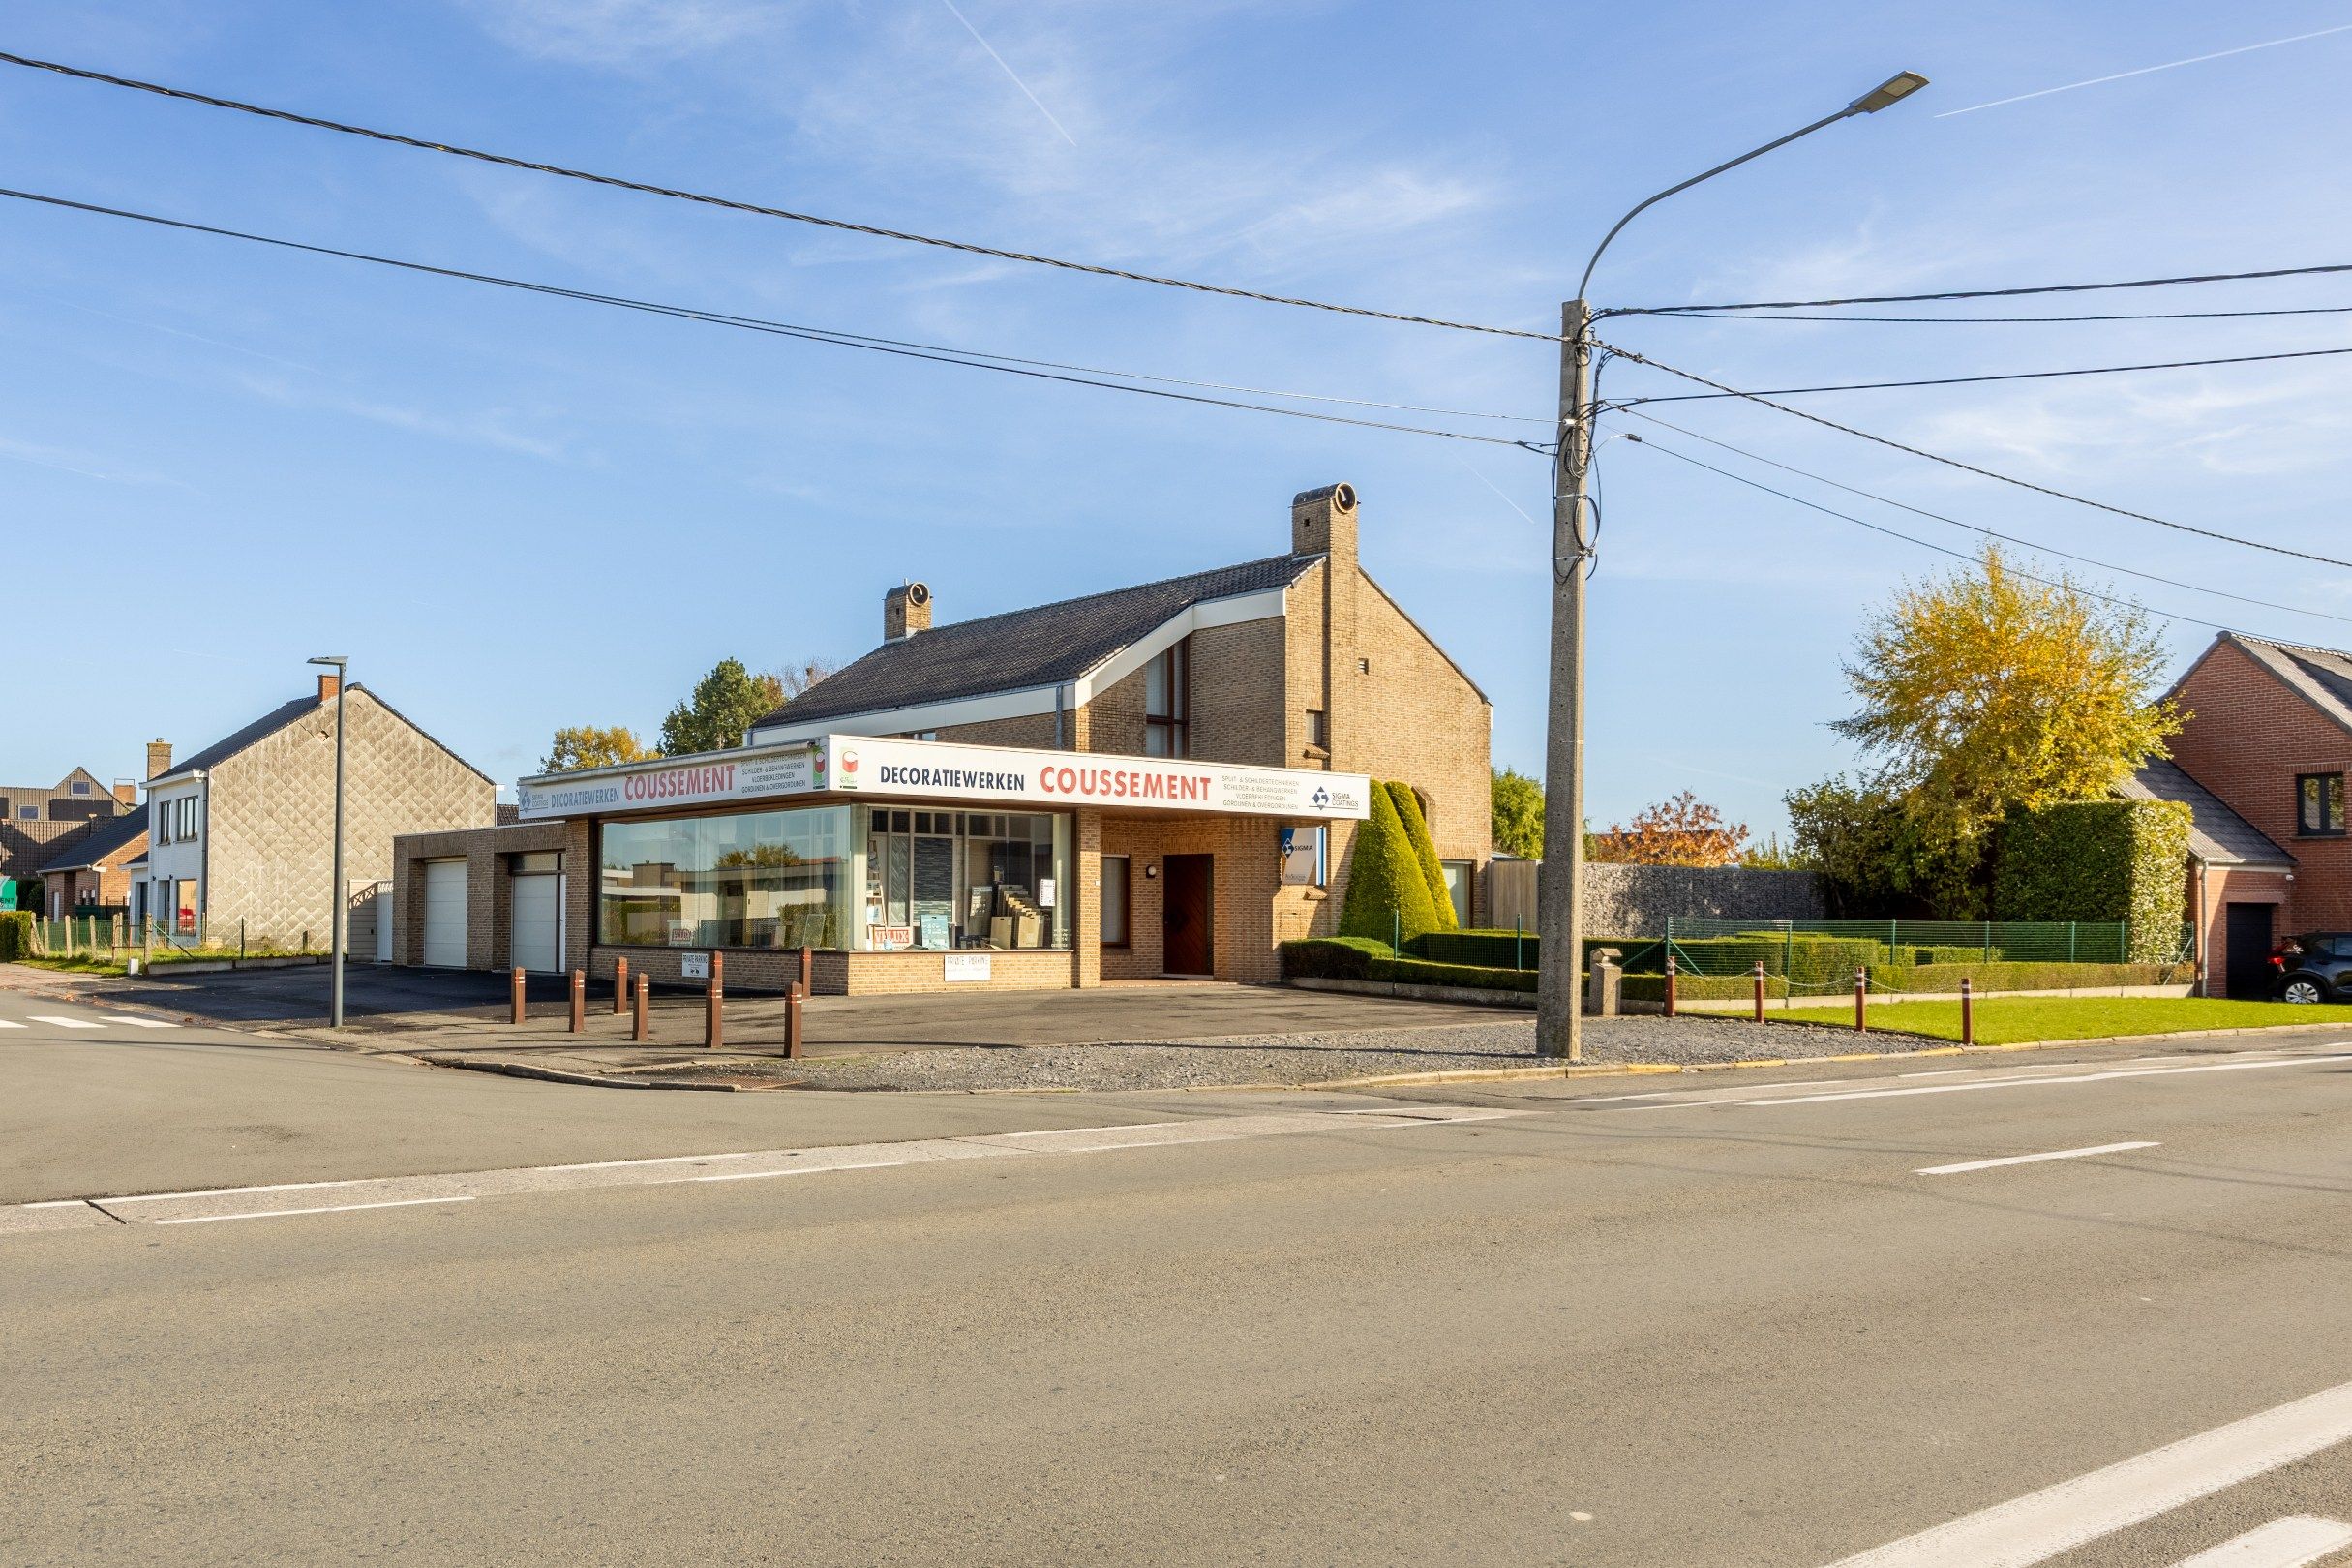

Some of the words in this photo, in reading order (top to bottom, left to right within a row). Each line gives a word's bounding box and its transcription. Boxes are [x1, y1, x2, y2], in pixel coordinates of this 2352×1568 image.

[769, 762, 805, 772] BEHANGWERKEN
[752, 772, 795, 783] VLOERBEKLEDINGEN
[551, 787, 619, 808] DECORATIEWERKEN
[625, 765, 735, 800] COUSSEMENT
[881, 766, 1024, 791] DECORATIEWERKEN
[1040, 766, 1211, 800] COUSSEMENT
[1256, 786, 1298, 795] BEHANGWERKEN
[1236, 793, 1285, 801] VLOERBEKLEDINGEN
[1332, 792, 1350, 800] SIGMA
